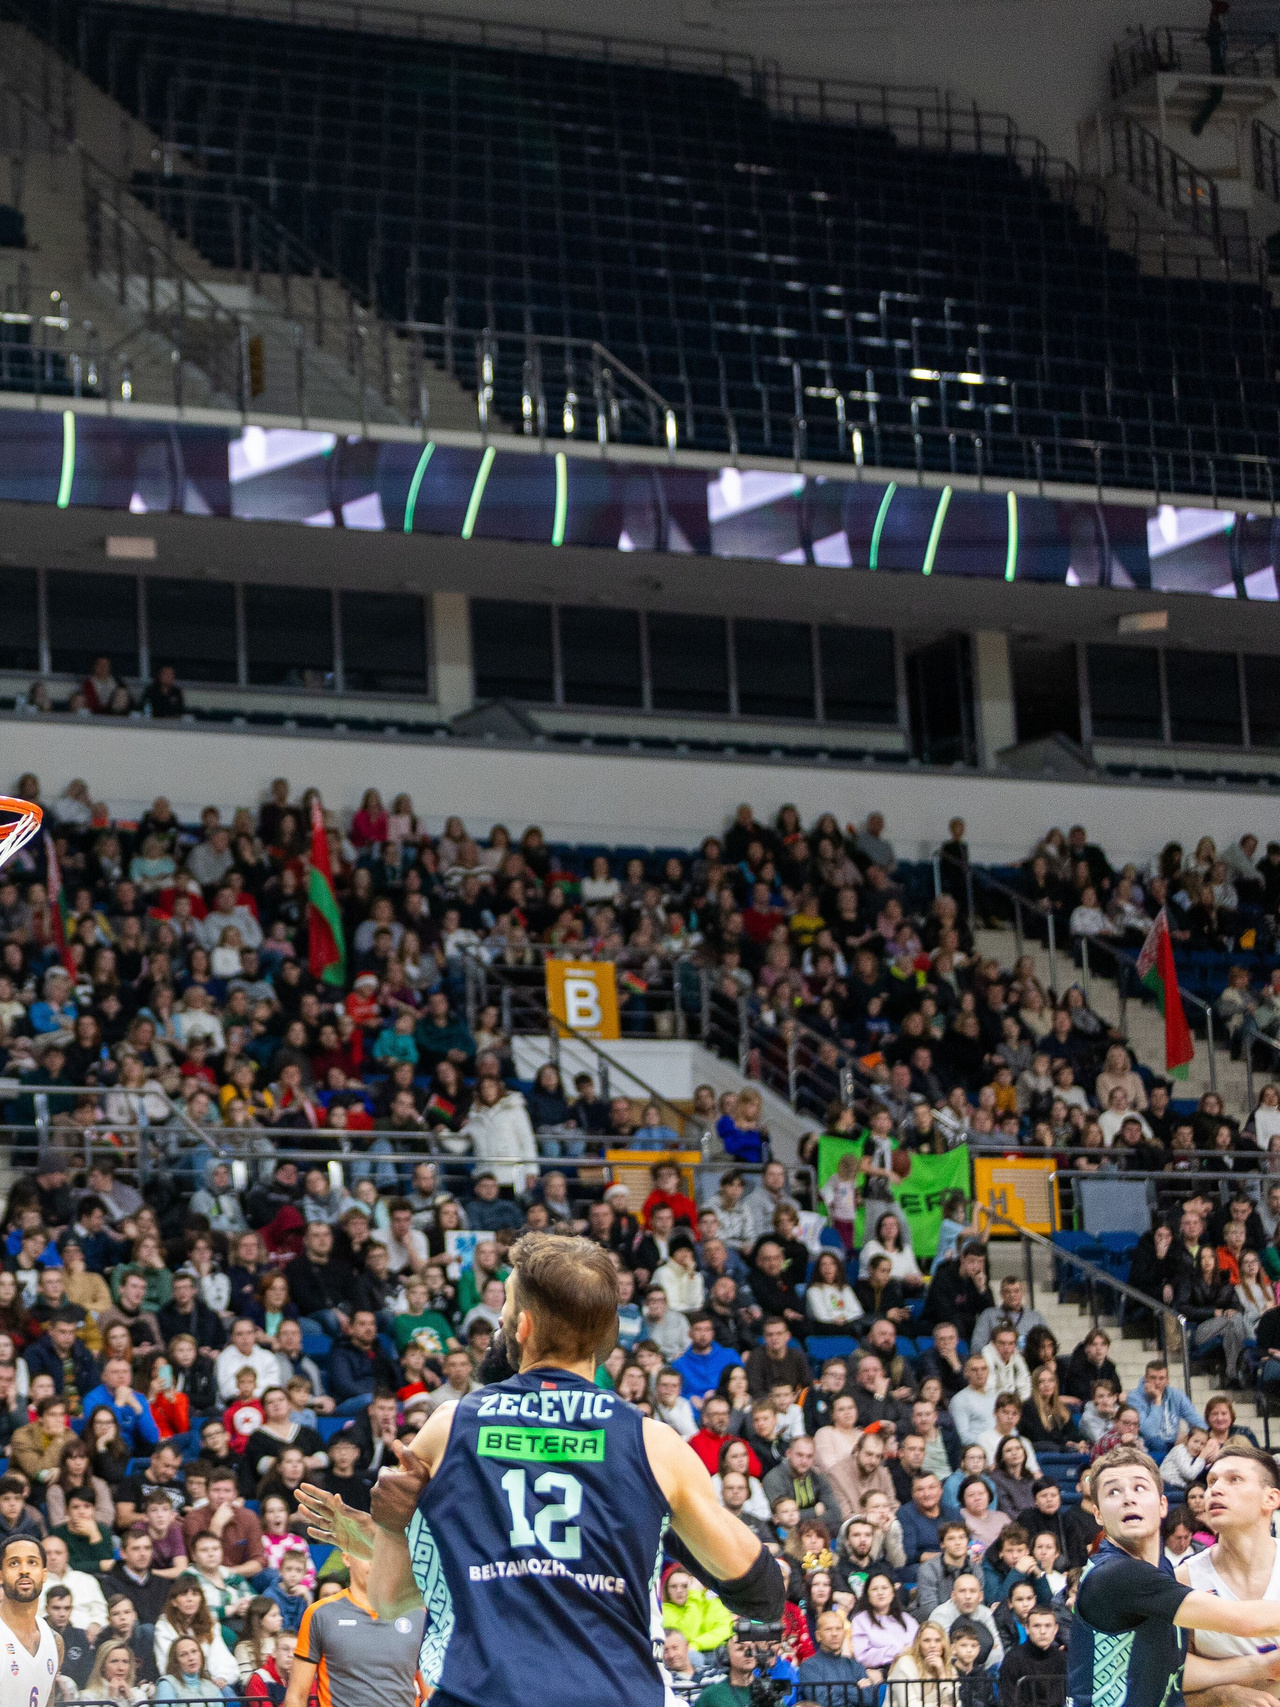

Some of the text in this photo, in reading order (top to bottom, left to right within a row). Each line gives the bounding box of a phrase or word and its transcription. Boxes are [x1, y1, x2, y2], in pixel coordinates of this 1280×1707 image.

[564, 979, 602, 1028] B
[477, 1390, 615, 1423] ZECEVIC
[501, 1468, 583, 1559] 12
